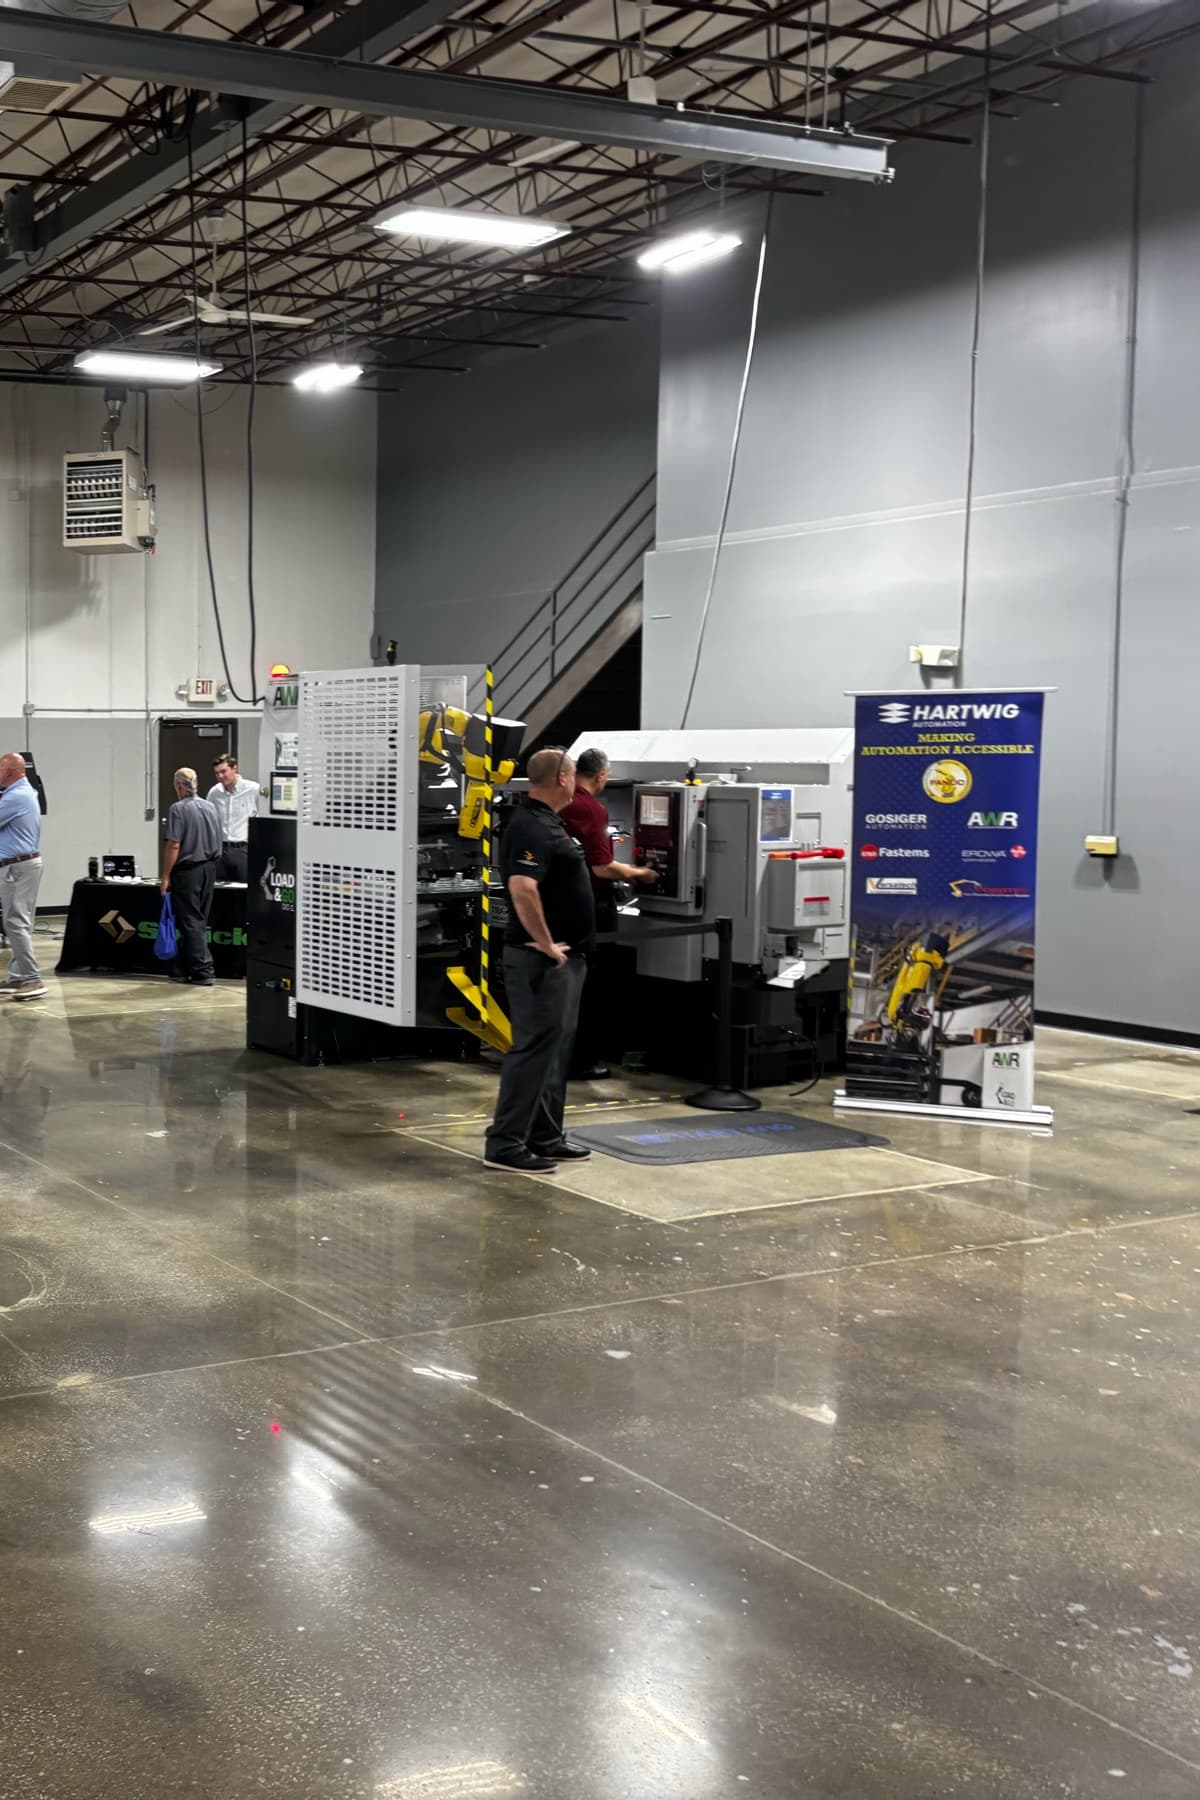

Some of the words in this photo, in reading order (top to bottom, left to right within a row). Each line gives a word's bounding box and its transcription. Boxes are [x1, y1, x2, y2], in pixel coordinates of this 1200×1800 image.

[196, 680, 213, 694] EXIT
[273, 686, 298, 706] AW
[913, 703, 1020, 721] HARTWIG
[918, 733, 976, 742] MAKING
[861, 746, 950, 756] AUTOMATION
[953, 744, 1035, 755] ACCESSIBLE
[865, 813, 927, 824] GOSIGER
[968, 811, 1018, 827] AWR
[879, 847, 930, 858] Fastems
[271, 872, 295, 888] LOAD
